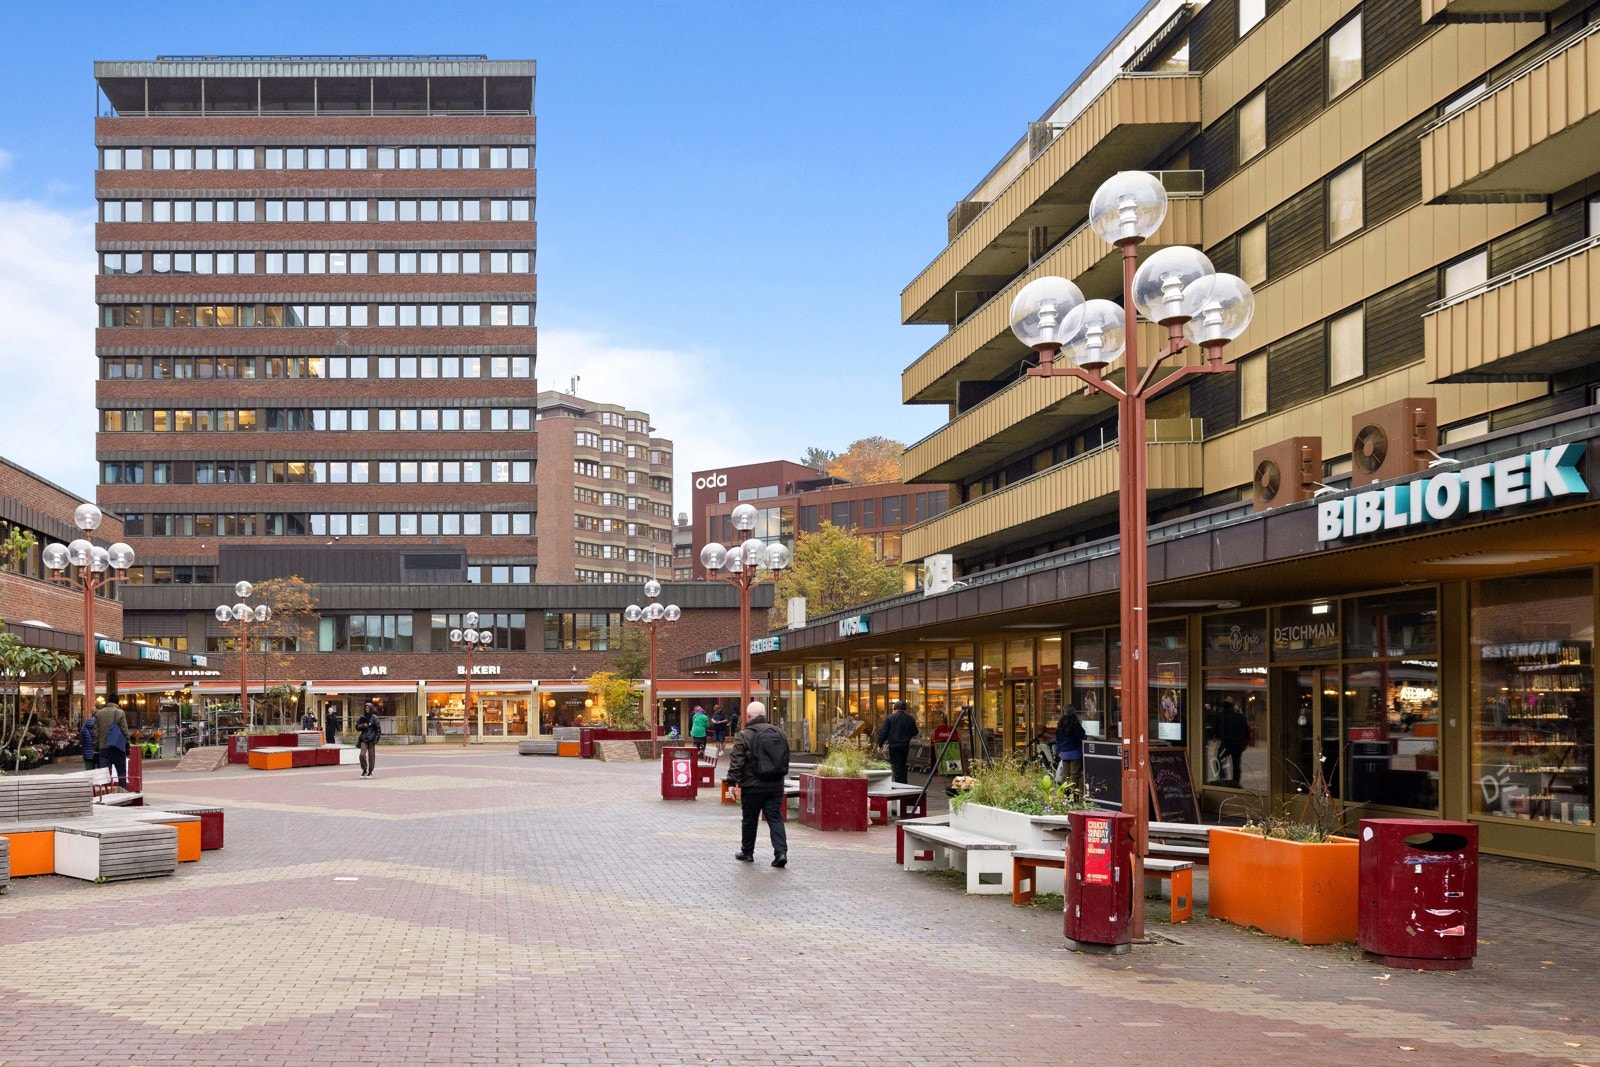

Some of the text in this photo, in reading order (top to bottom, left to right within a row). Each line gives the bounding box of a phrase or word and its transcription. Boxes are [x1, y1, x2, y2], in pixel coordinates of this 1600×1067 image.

[696, 472, 727, 490] oda
[1318, 443, 1589, 542] BIBLIOTEK
[839, 614, 868, 637] KIOSK
[1274, 623, 1335, 642] DEICHMAN
[361, 666, 387, 675] BAR
[1087, 829, 1109, 838] SUNDAY
